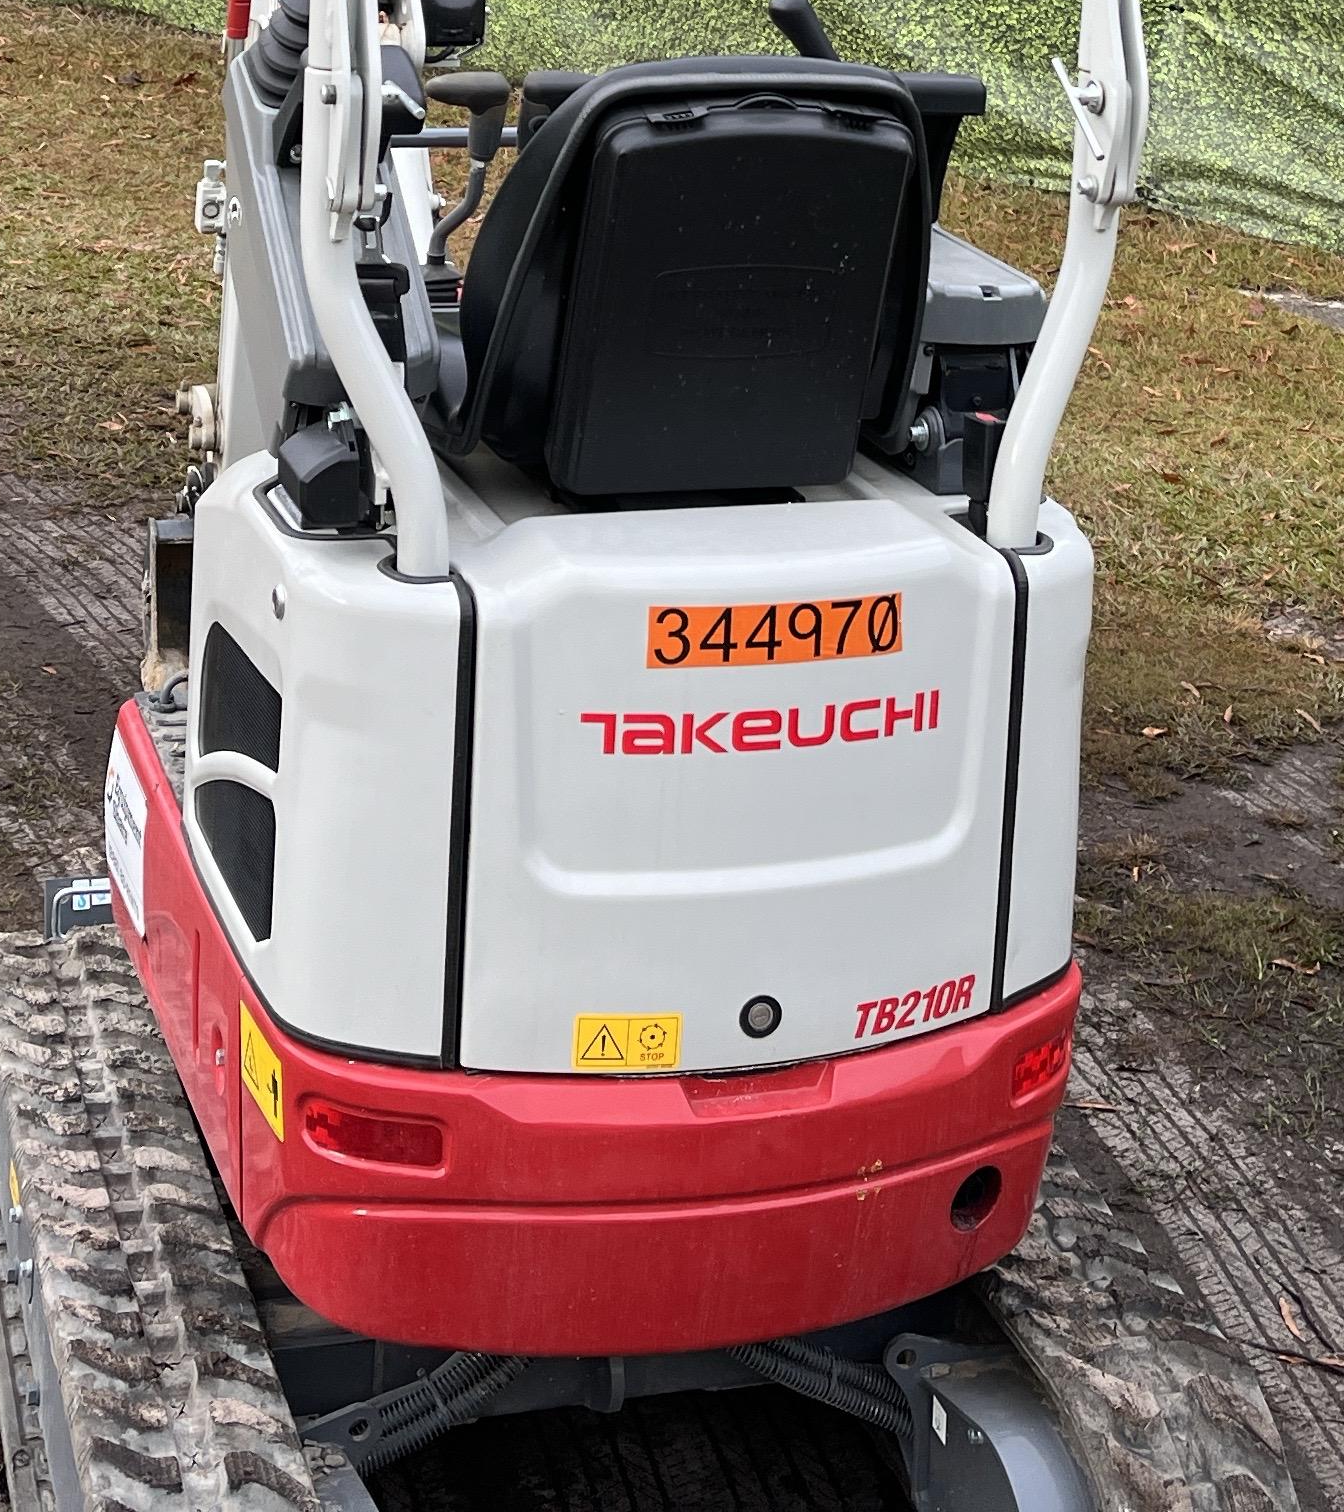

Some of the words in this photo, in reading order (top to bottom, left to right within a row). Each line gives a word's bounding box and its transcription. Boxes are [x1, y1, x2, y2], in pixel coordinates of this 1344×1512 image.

[653, 593, 898, 665] 344970
[580, 689, 940, 755] TAKEUCHI
[854, 974, 976, 1039] TB210R
[639, 1052, 665, 1062] STOP
